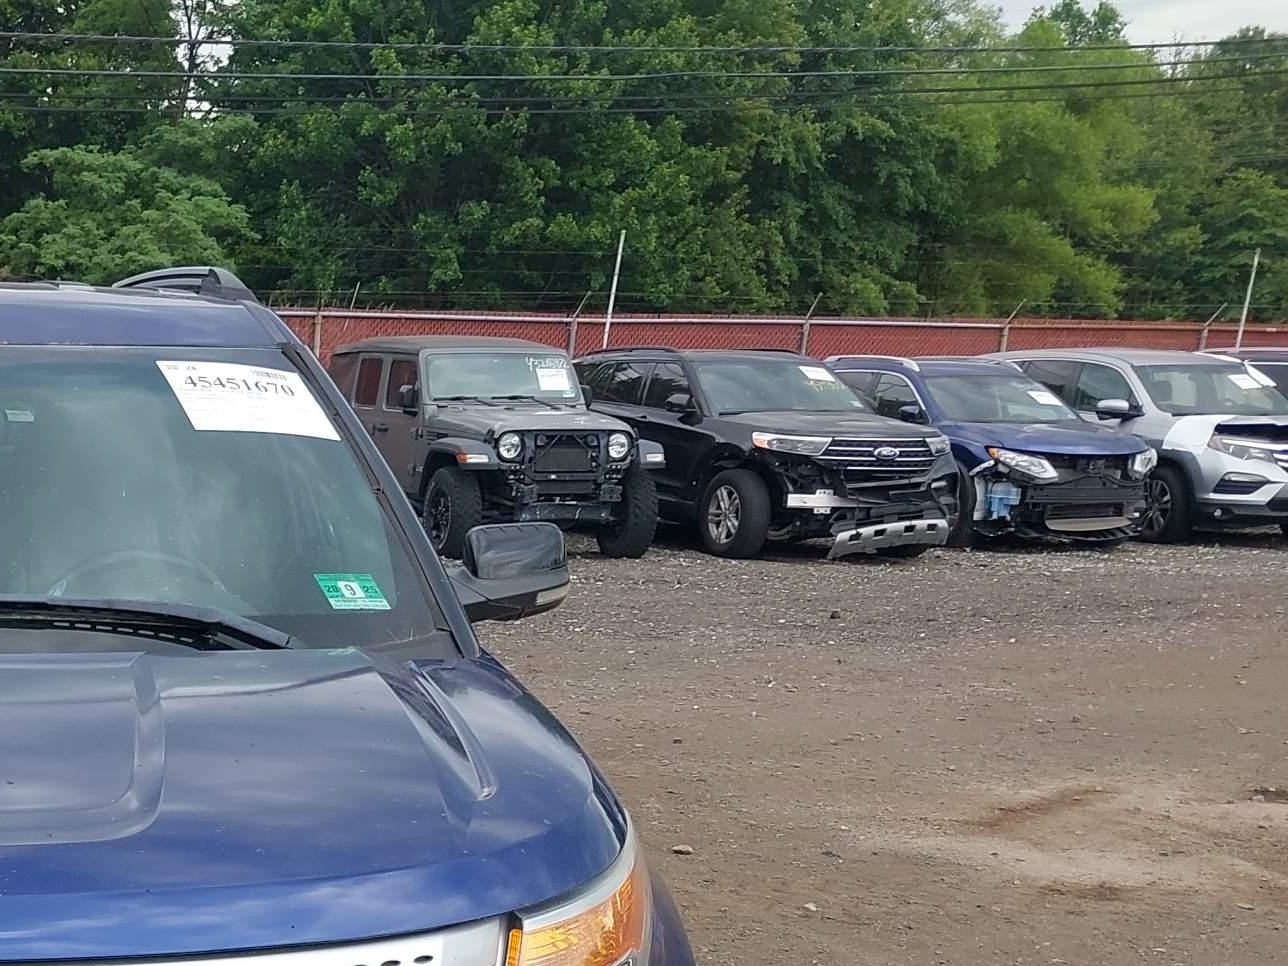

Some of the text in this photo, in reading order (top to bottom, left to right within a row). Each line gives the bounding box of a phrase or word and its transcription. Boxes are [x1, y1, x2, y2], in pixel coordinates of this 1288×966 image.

[184, 375, 296, 397] 45451670
[324, 583, 379, 596] 20 9 25
